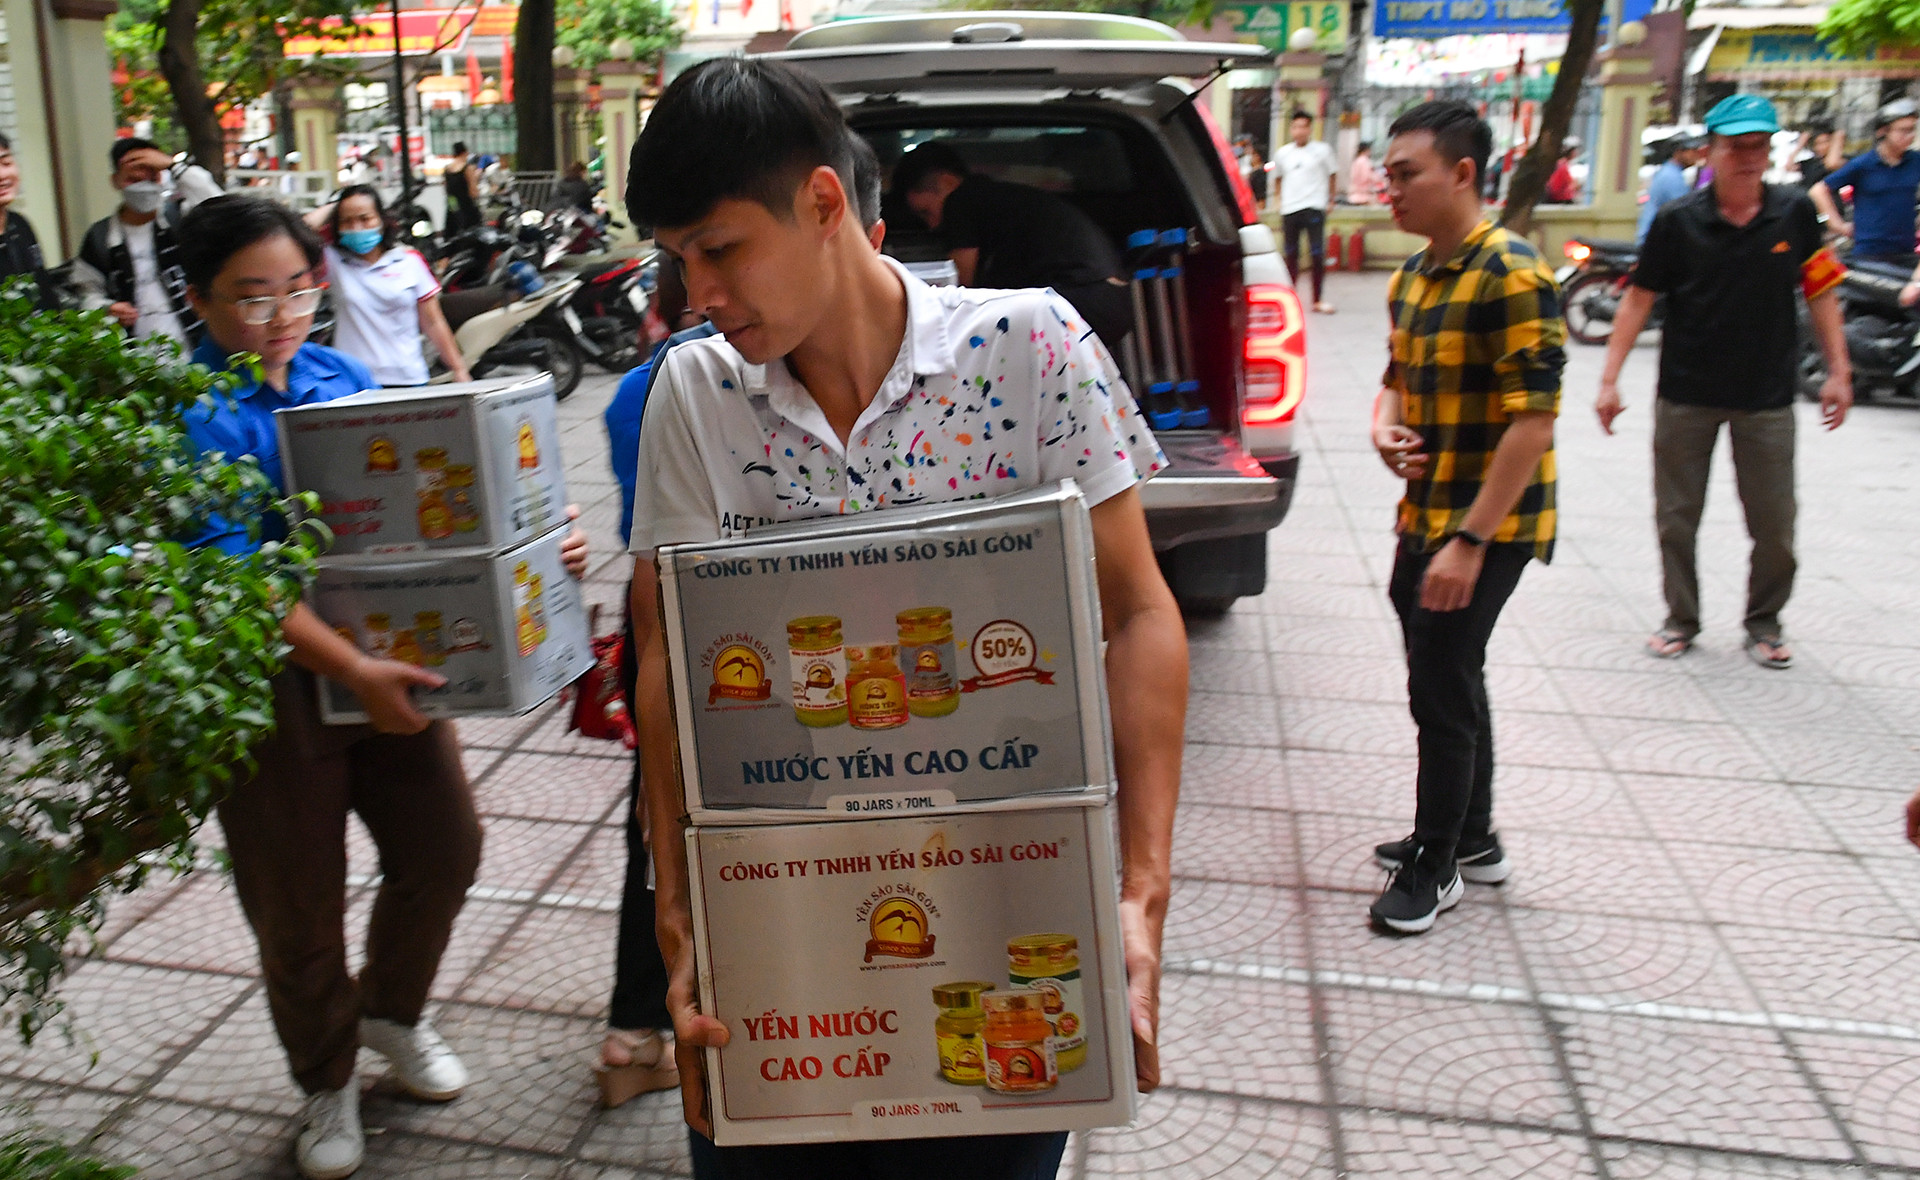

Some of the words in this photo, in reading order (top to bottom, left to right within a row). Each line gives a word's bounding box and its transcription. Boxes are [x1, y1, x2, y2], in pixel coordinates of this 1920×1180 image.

[1301, 4, 1340, 31] 18
[694, 559, 752, 579] CÔNG
[758, 556, 780, 574] TY
[787, 552, 844, 572] TNHH
[850, 543, 888, 566] YẾN
[982, 637, 1026, 659] 50%
[742, 752, 830, 784] NƯỚC
[838, 746, 894, 778] YẾN
[904, 748, 968, 775] CAO
[978, 737, 1040, 771] CẤP
[846, 800, 860, 812] 90
[862, 799, 894, 811] JARS
[904, 797, 935, 808] 70ML
[719, 862, 778, 882] CÔNG
[784, 860, 808, 877] TY
[814, 856, 872, 876] TNHH
[876, 848, 915, 870] YẾN
[922, 847, 964, 868] SÀO
[970, 843, 1004, 864] SÀI
[742, 1008, 800, 1042] YẾN
[808, 1006, 898, 1038] NƯỚC
[760, 1056, 823, 1082] CAO
[832, 1045, 891, 1078] CẤP
[872, 1106, 886, 1117] 90
[889, 1104, 920, 1116] JARS
[930, 1102, 962, 1114] 70ML
